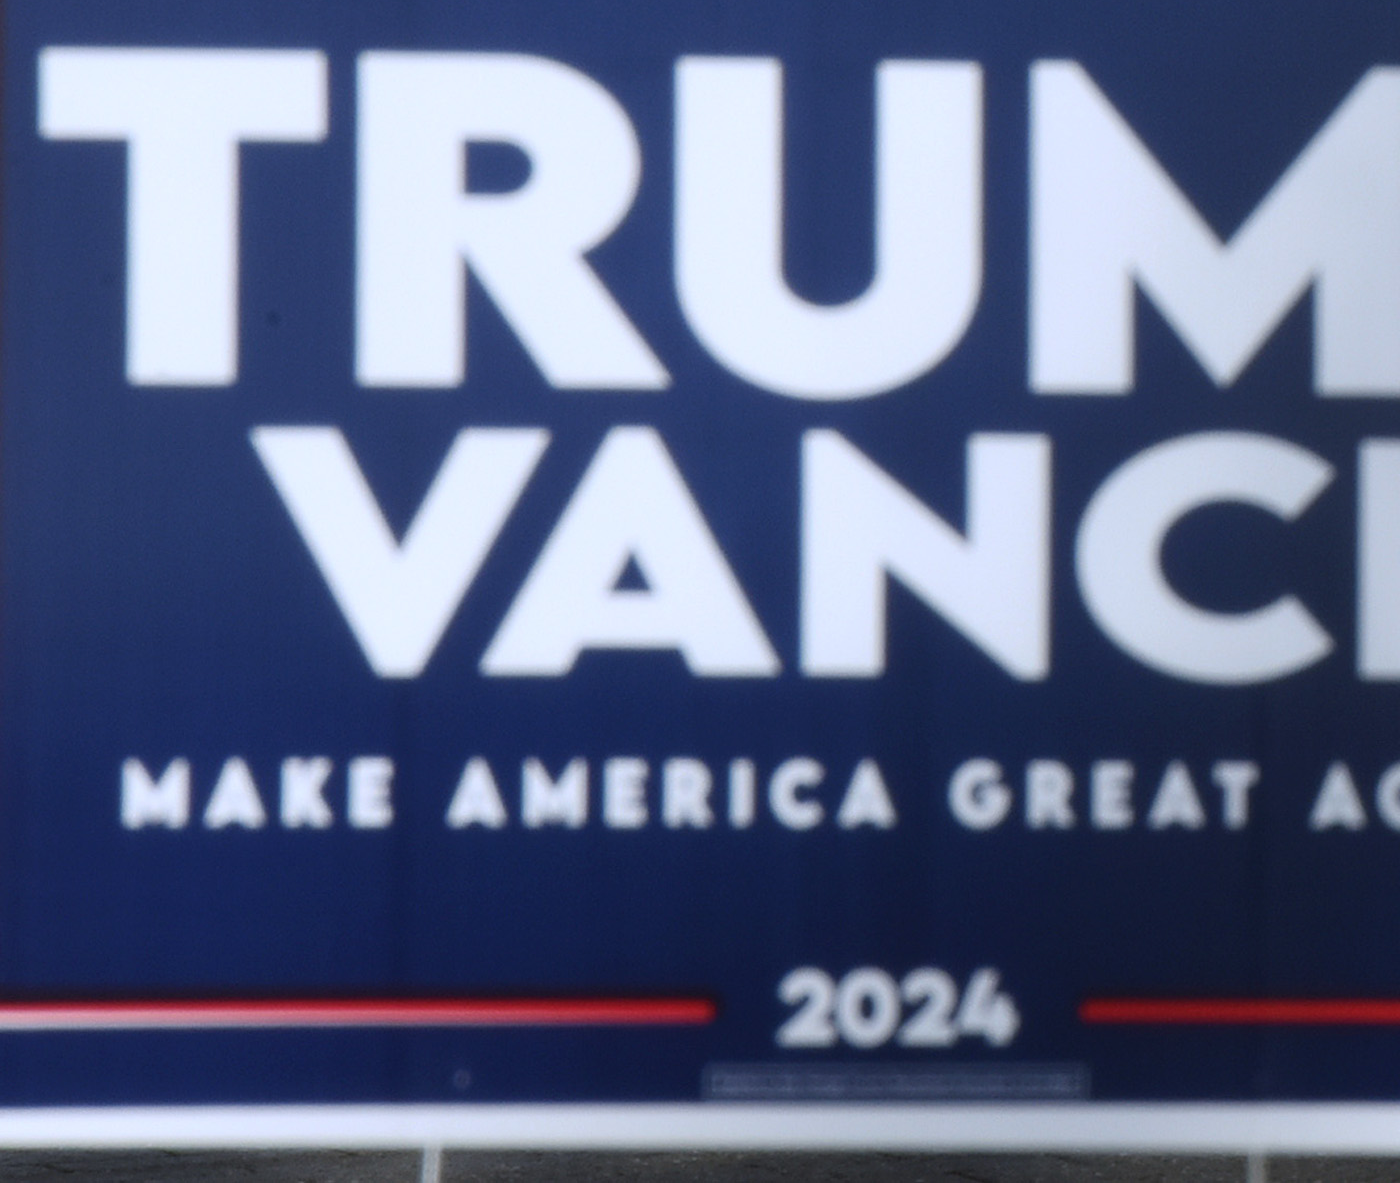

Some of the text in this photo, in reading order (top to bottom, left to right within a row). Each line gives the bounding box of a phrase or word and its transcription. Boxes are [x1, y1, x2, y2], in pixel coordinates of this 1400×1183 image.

[120, 757, 393, 829] MAKE
[448, 758, 893, 828] AMERICA
[950, 759, 1254, 828] GREAT
[778, 967, 1019, 1047] 2024
